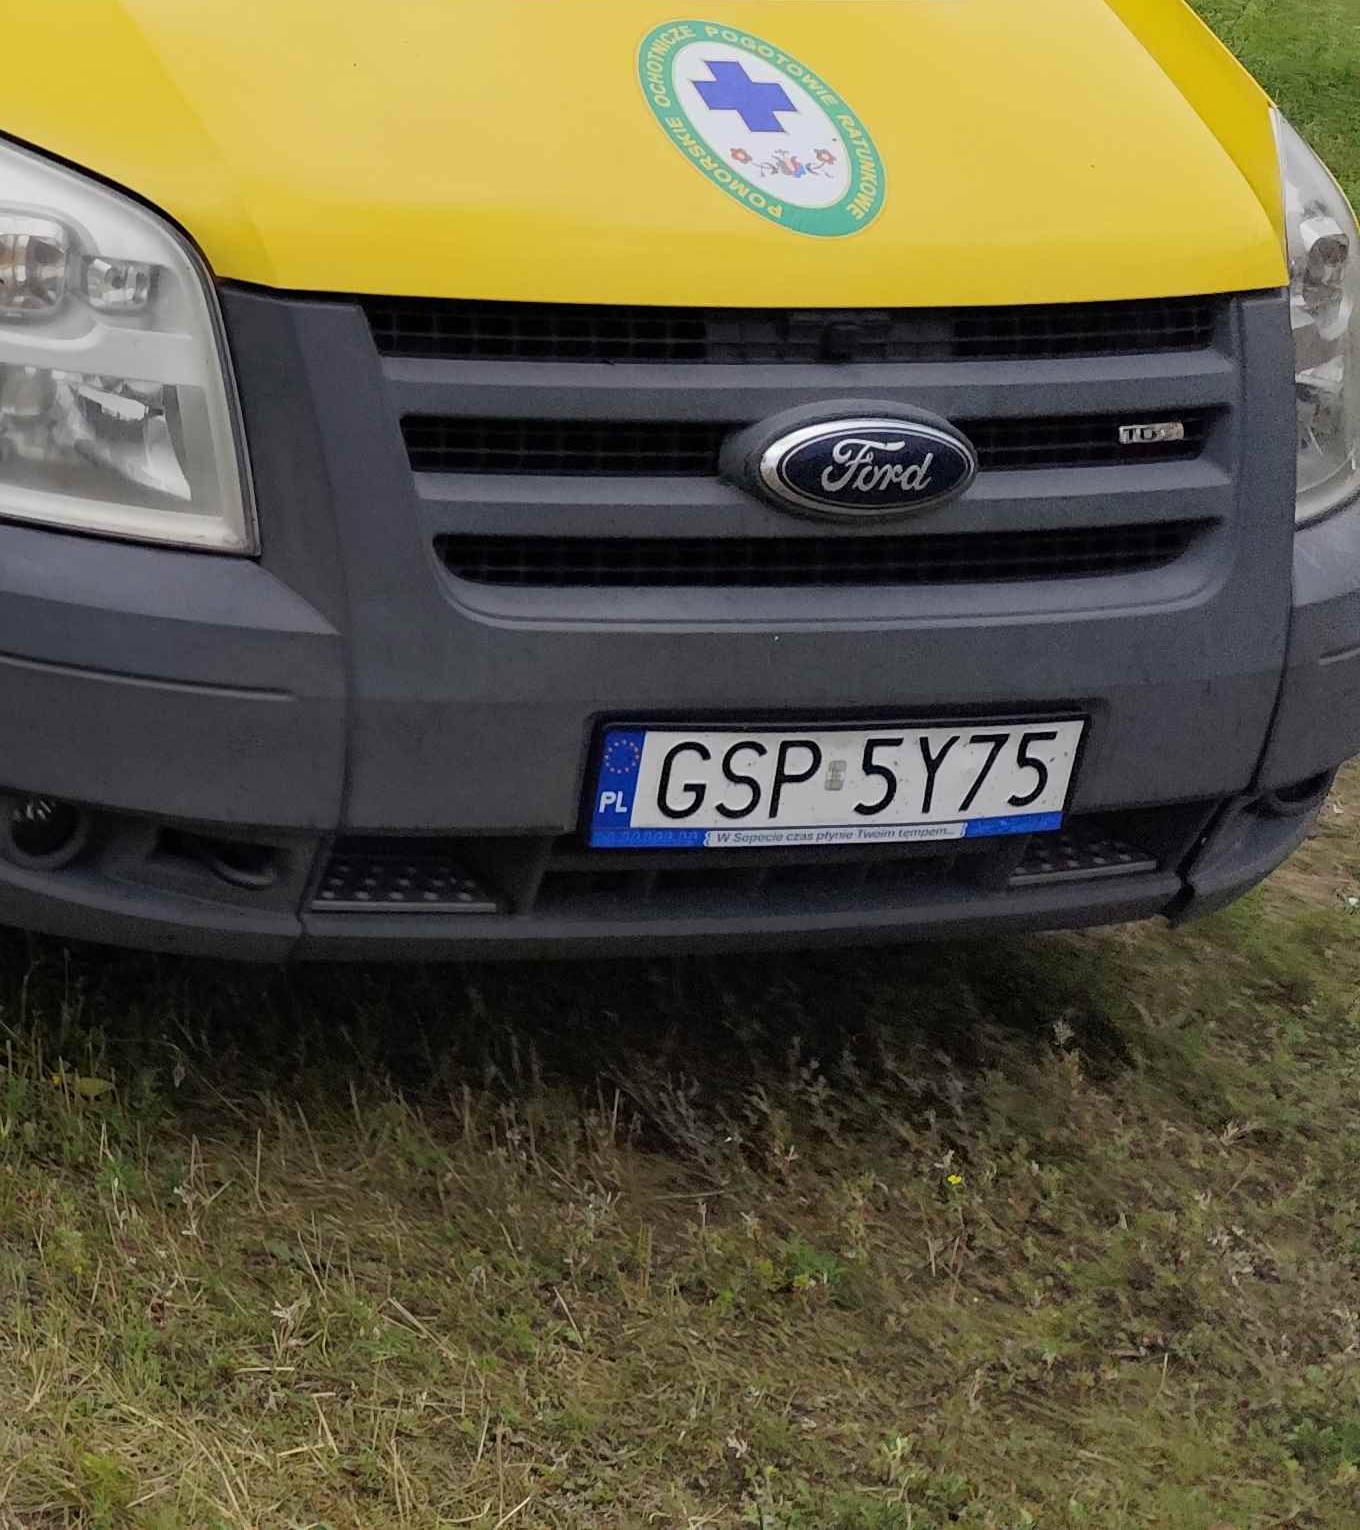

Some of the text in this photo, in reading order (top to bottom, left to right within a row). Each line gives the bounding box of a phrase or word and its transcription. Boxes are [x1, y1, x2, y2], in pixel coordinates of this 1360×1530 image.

[647, 25, 878, 220] POMORSKIE OCHOTNICZE POGOTOWIE RATUNKOWE
[821, 438, 933, 493] Ford
[598, 791, 628, 813] PL
[655, 730, 1058, 819] GSP 5Y75
